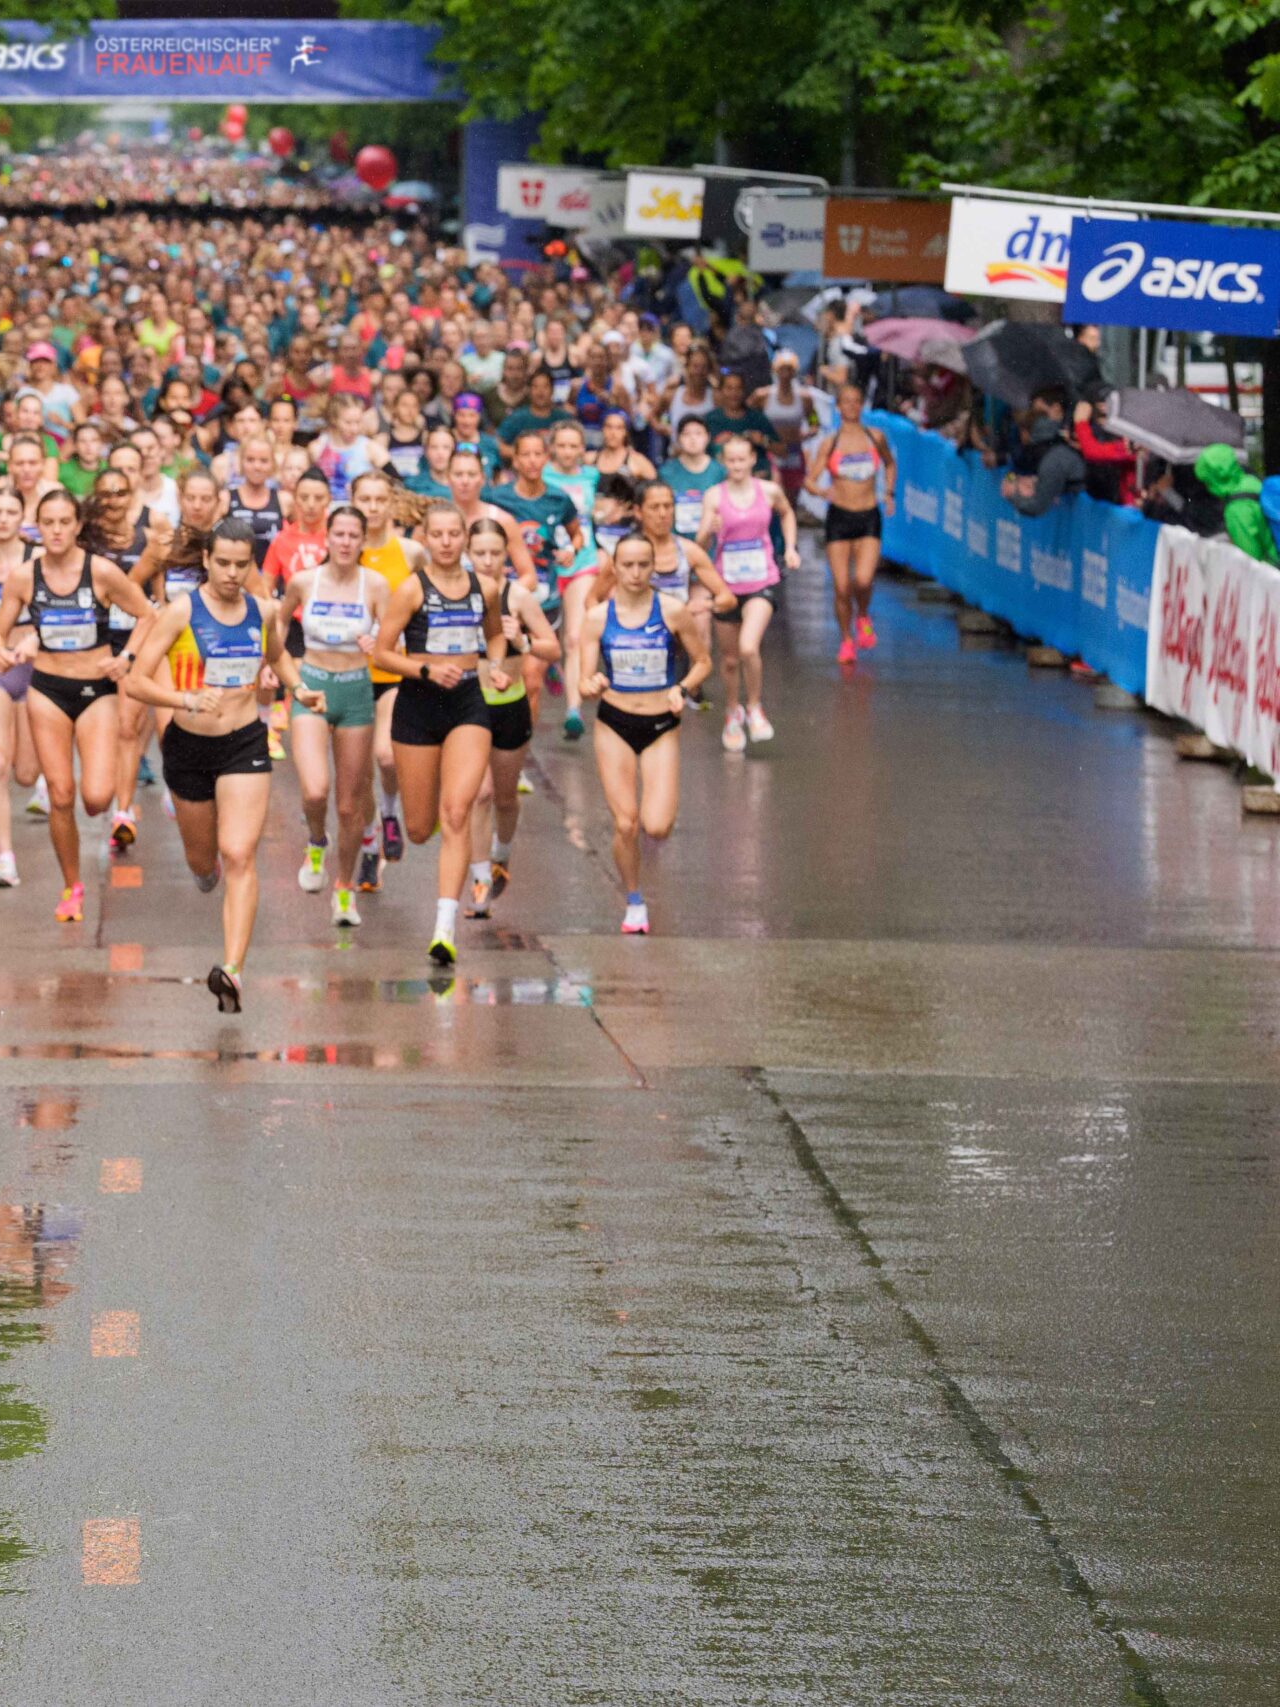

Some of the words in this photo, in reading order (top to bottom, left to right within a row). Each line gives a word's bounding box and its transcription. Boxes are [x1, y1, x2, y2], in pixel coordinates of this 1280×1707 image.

[94, 35, 272, 52] ÖSTERREICHISCHER
[94, 53, 272, 76] FRAUENLAUF
[1140, 256, 1261, 304] asics
